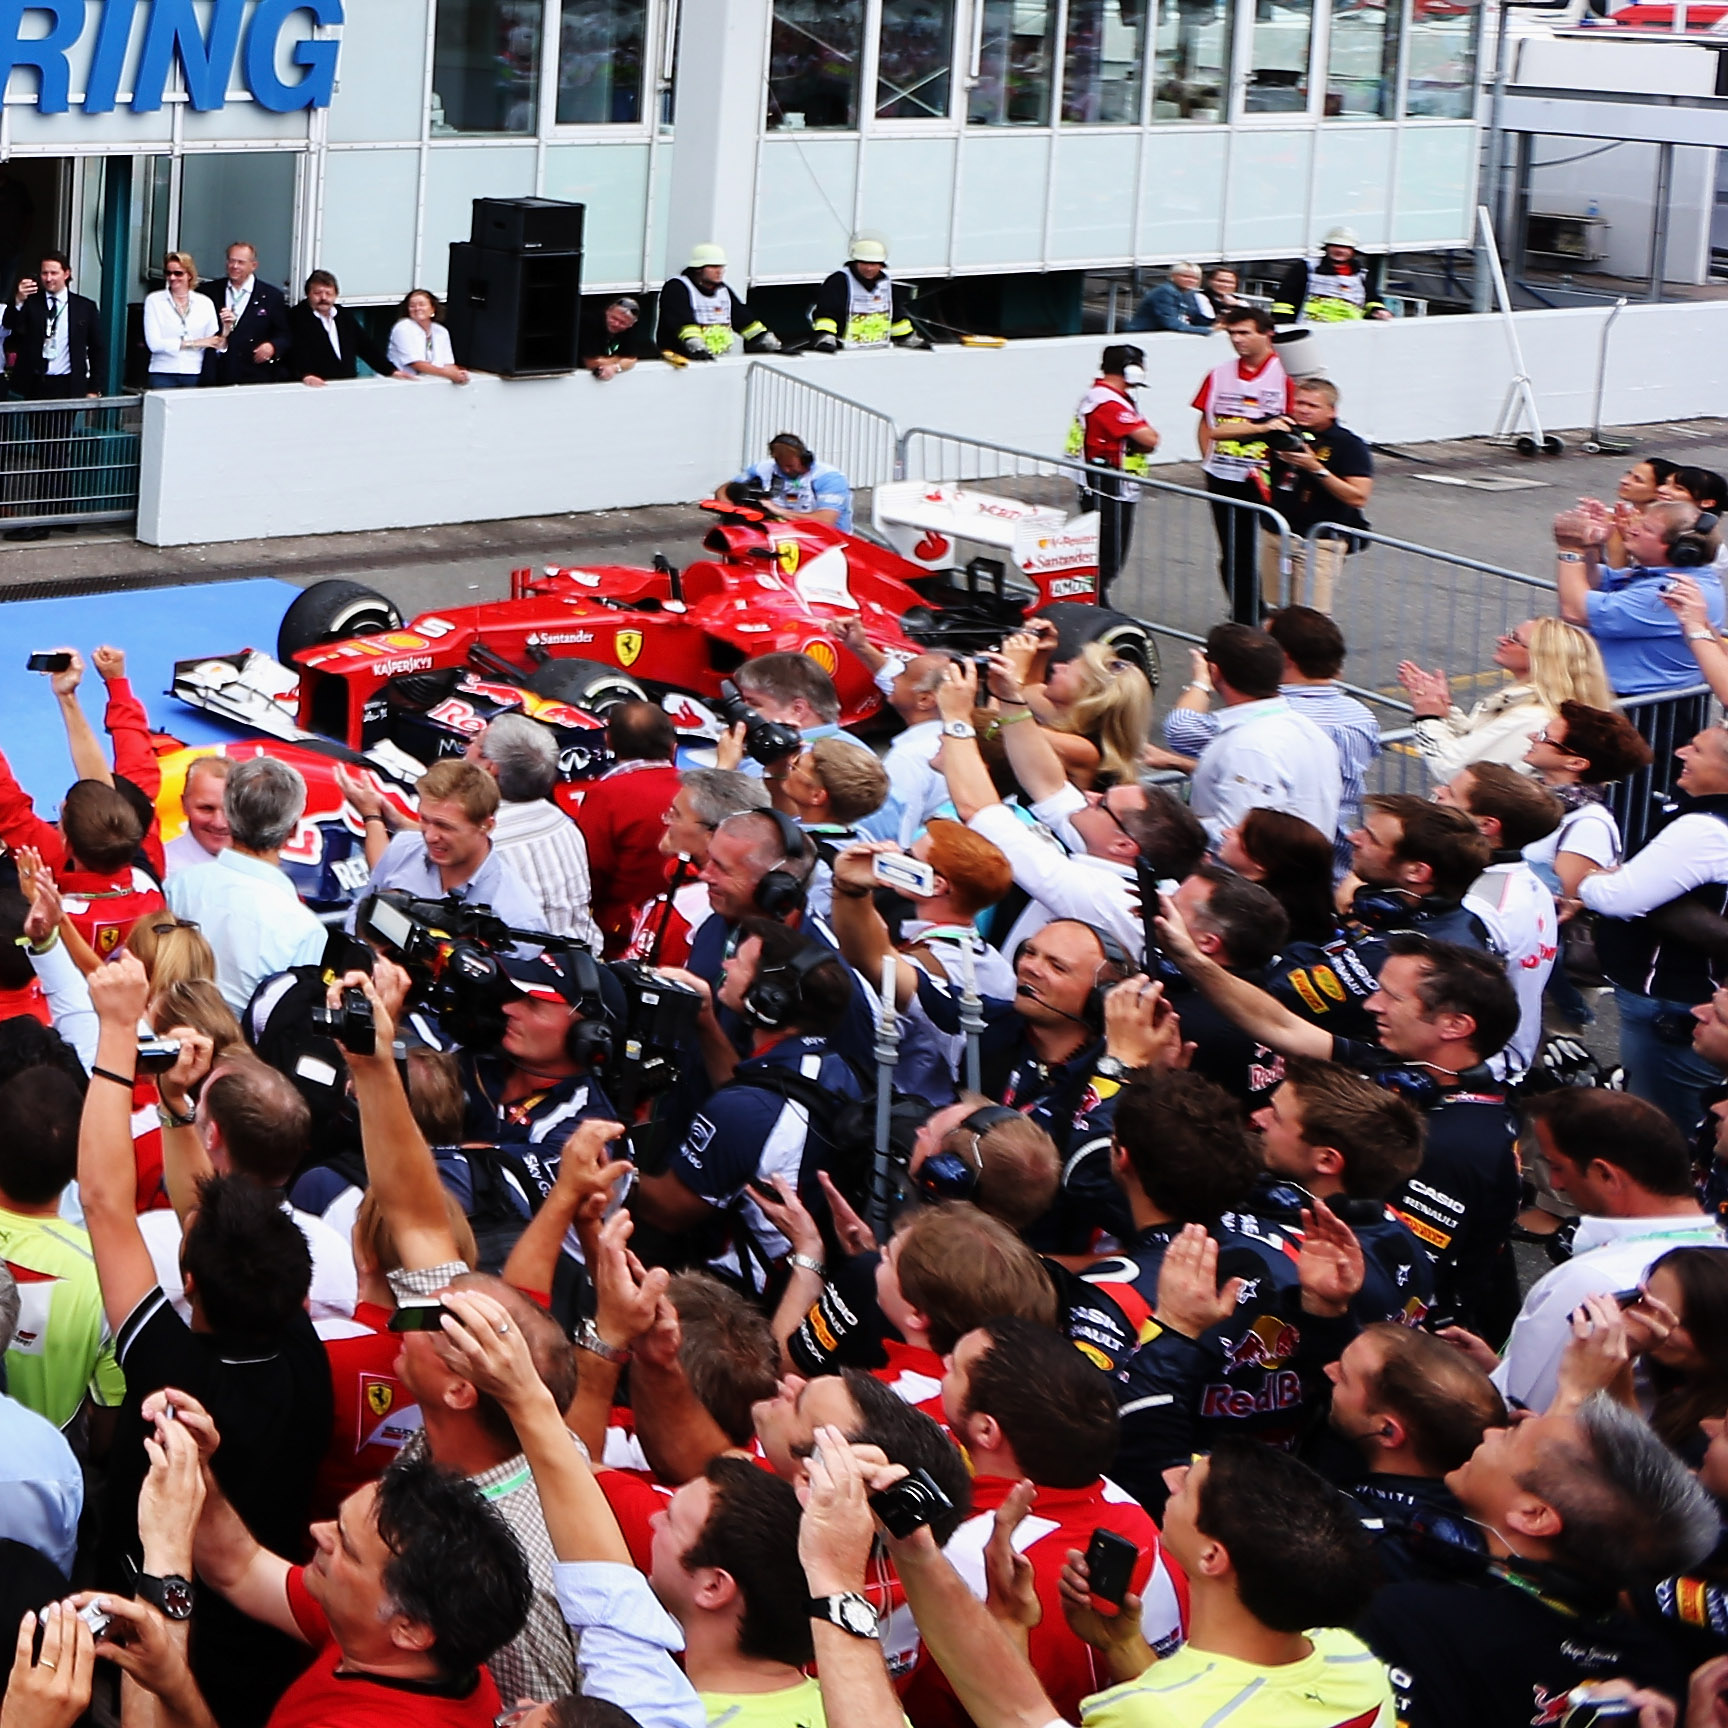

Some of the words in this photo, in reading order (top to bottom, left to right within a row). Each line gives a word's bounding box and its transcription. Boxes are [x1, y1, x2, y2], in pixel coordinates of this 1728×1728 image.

[539, 630, 595, 645] Santander
[1402, 1195, 1460, 1229] RENAULT
[1407, 1179, 1466, 1214] CASIO
[1201, 1373, 1274, 1418] Red
